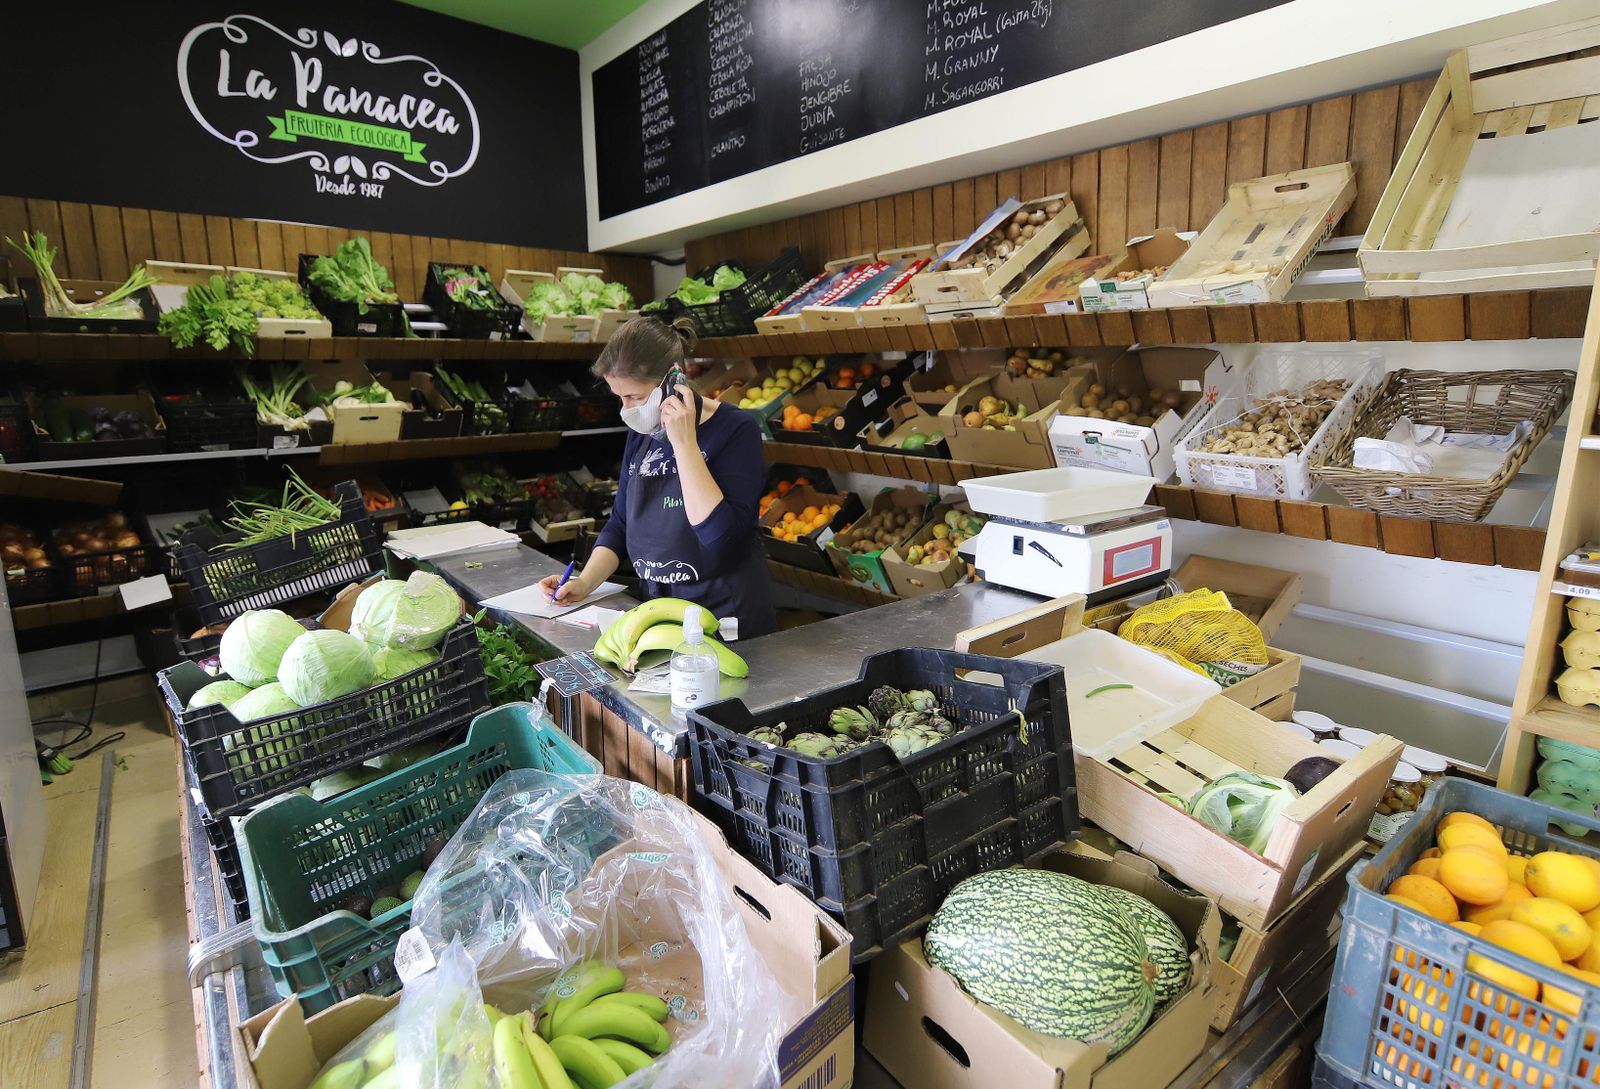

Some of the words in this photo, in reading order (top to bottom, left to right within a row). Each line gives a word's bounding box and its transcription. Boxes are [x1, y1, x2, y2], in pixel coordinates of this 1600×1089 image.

[942, 2, 988, 29] ROYAL
[944, 21, 993, 52] ROYAL
[925, 60, 940, 83] M.
[943, 43, 999, 76] GRANNY
[217, 48, 278, 101] La
[291, 50, 461, 136] Panacea
[801, 68, 837, 92] HINOJO
[800, 79, 852, 113] JENGIBRE
[924, 91, 940, 111] M.
[314, 173, 356, 196] Desde
[359, 182, 385, 199] 1987
[1569, 586, 1591, 596] 4.09
